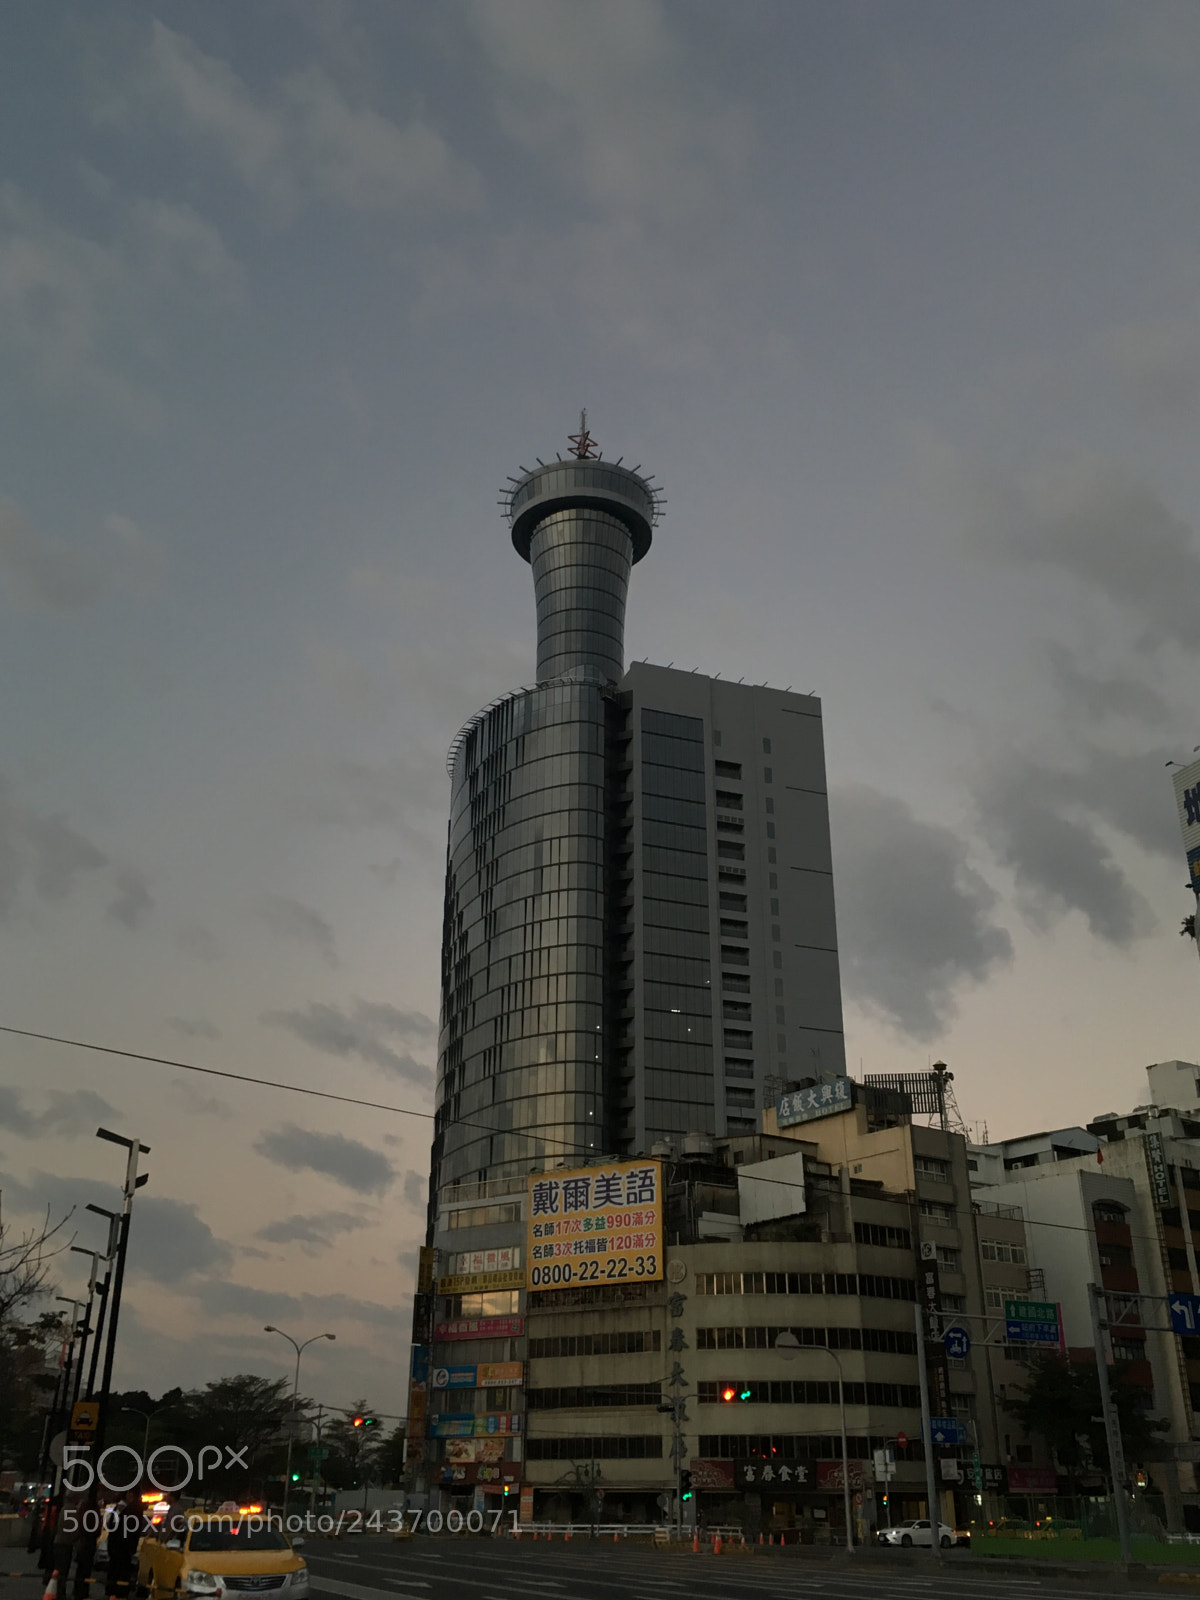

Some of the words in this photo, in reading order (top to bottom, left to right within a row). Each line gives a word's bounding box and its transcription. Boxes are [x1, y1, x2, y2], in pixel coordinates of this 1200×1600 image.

[533, 1168, 656, 1216] 戴爾美語
[1153, 1164, 1169, 1204] HOTEL
[533, 1210, 656, 1238] 名師17次多益990滿分
[532, 1232, 656, 1259] 名師3次托福皆120滿分
[531, 1255, 657, 1286] 0800-22-22-33
[743, 1464, 809, 1482] 富春食堂
